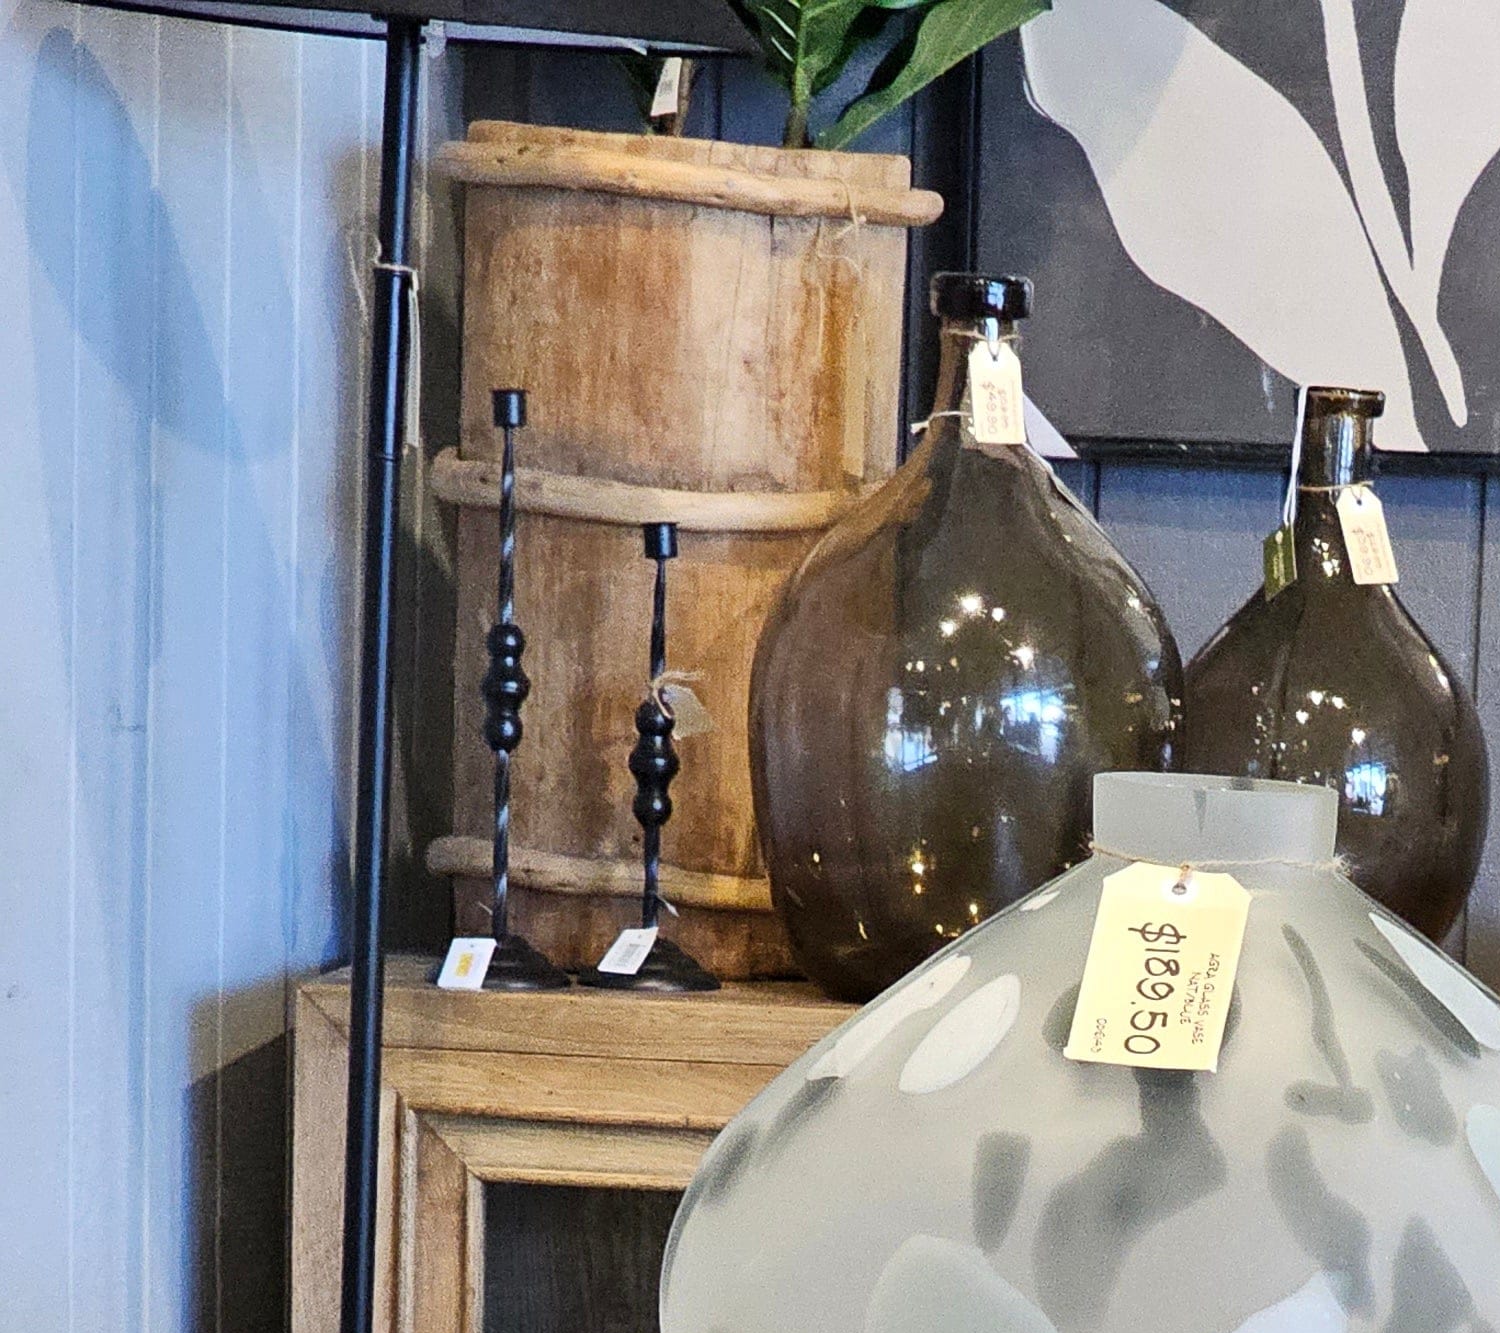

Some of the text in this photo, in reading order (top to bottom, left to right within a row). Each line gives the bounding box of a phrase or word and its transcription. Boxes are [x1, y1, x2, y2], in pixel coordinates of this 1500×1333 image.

[1124, 921, 1187, 1055] $189.50
[1196, 982, 1216, 1018] GLASS
[1191, 1019, 1205, 1046] VASE
